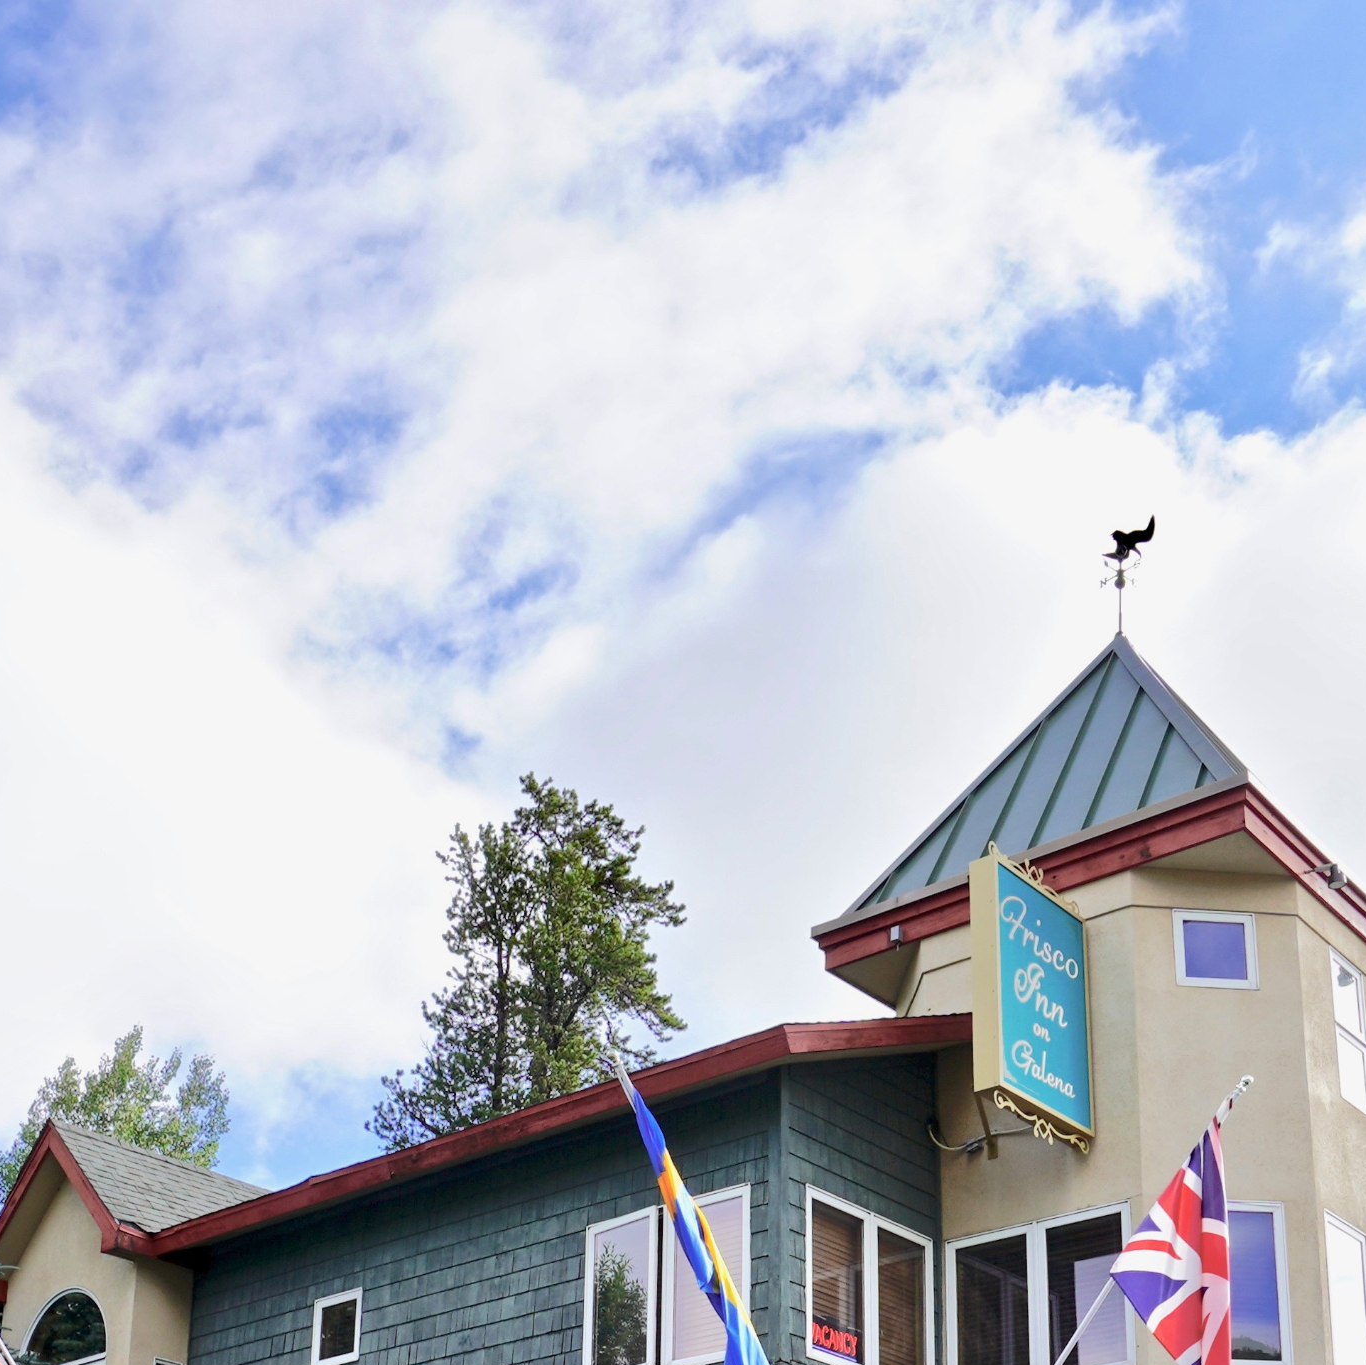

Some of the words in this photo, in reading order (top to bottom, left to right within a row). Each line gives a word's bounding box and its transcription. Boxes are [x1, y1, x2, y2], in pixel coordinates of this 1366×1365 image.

[1000, 896, 1079, 979] Frisco
[1014, 962, 1068, 1028] Inn
[1033, 1023, 1051, 1042] on
[1011, 1039, 1076, 1099] Galena
